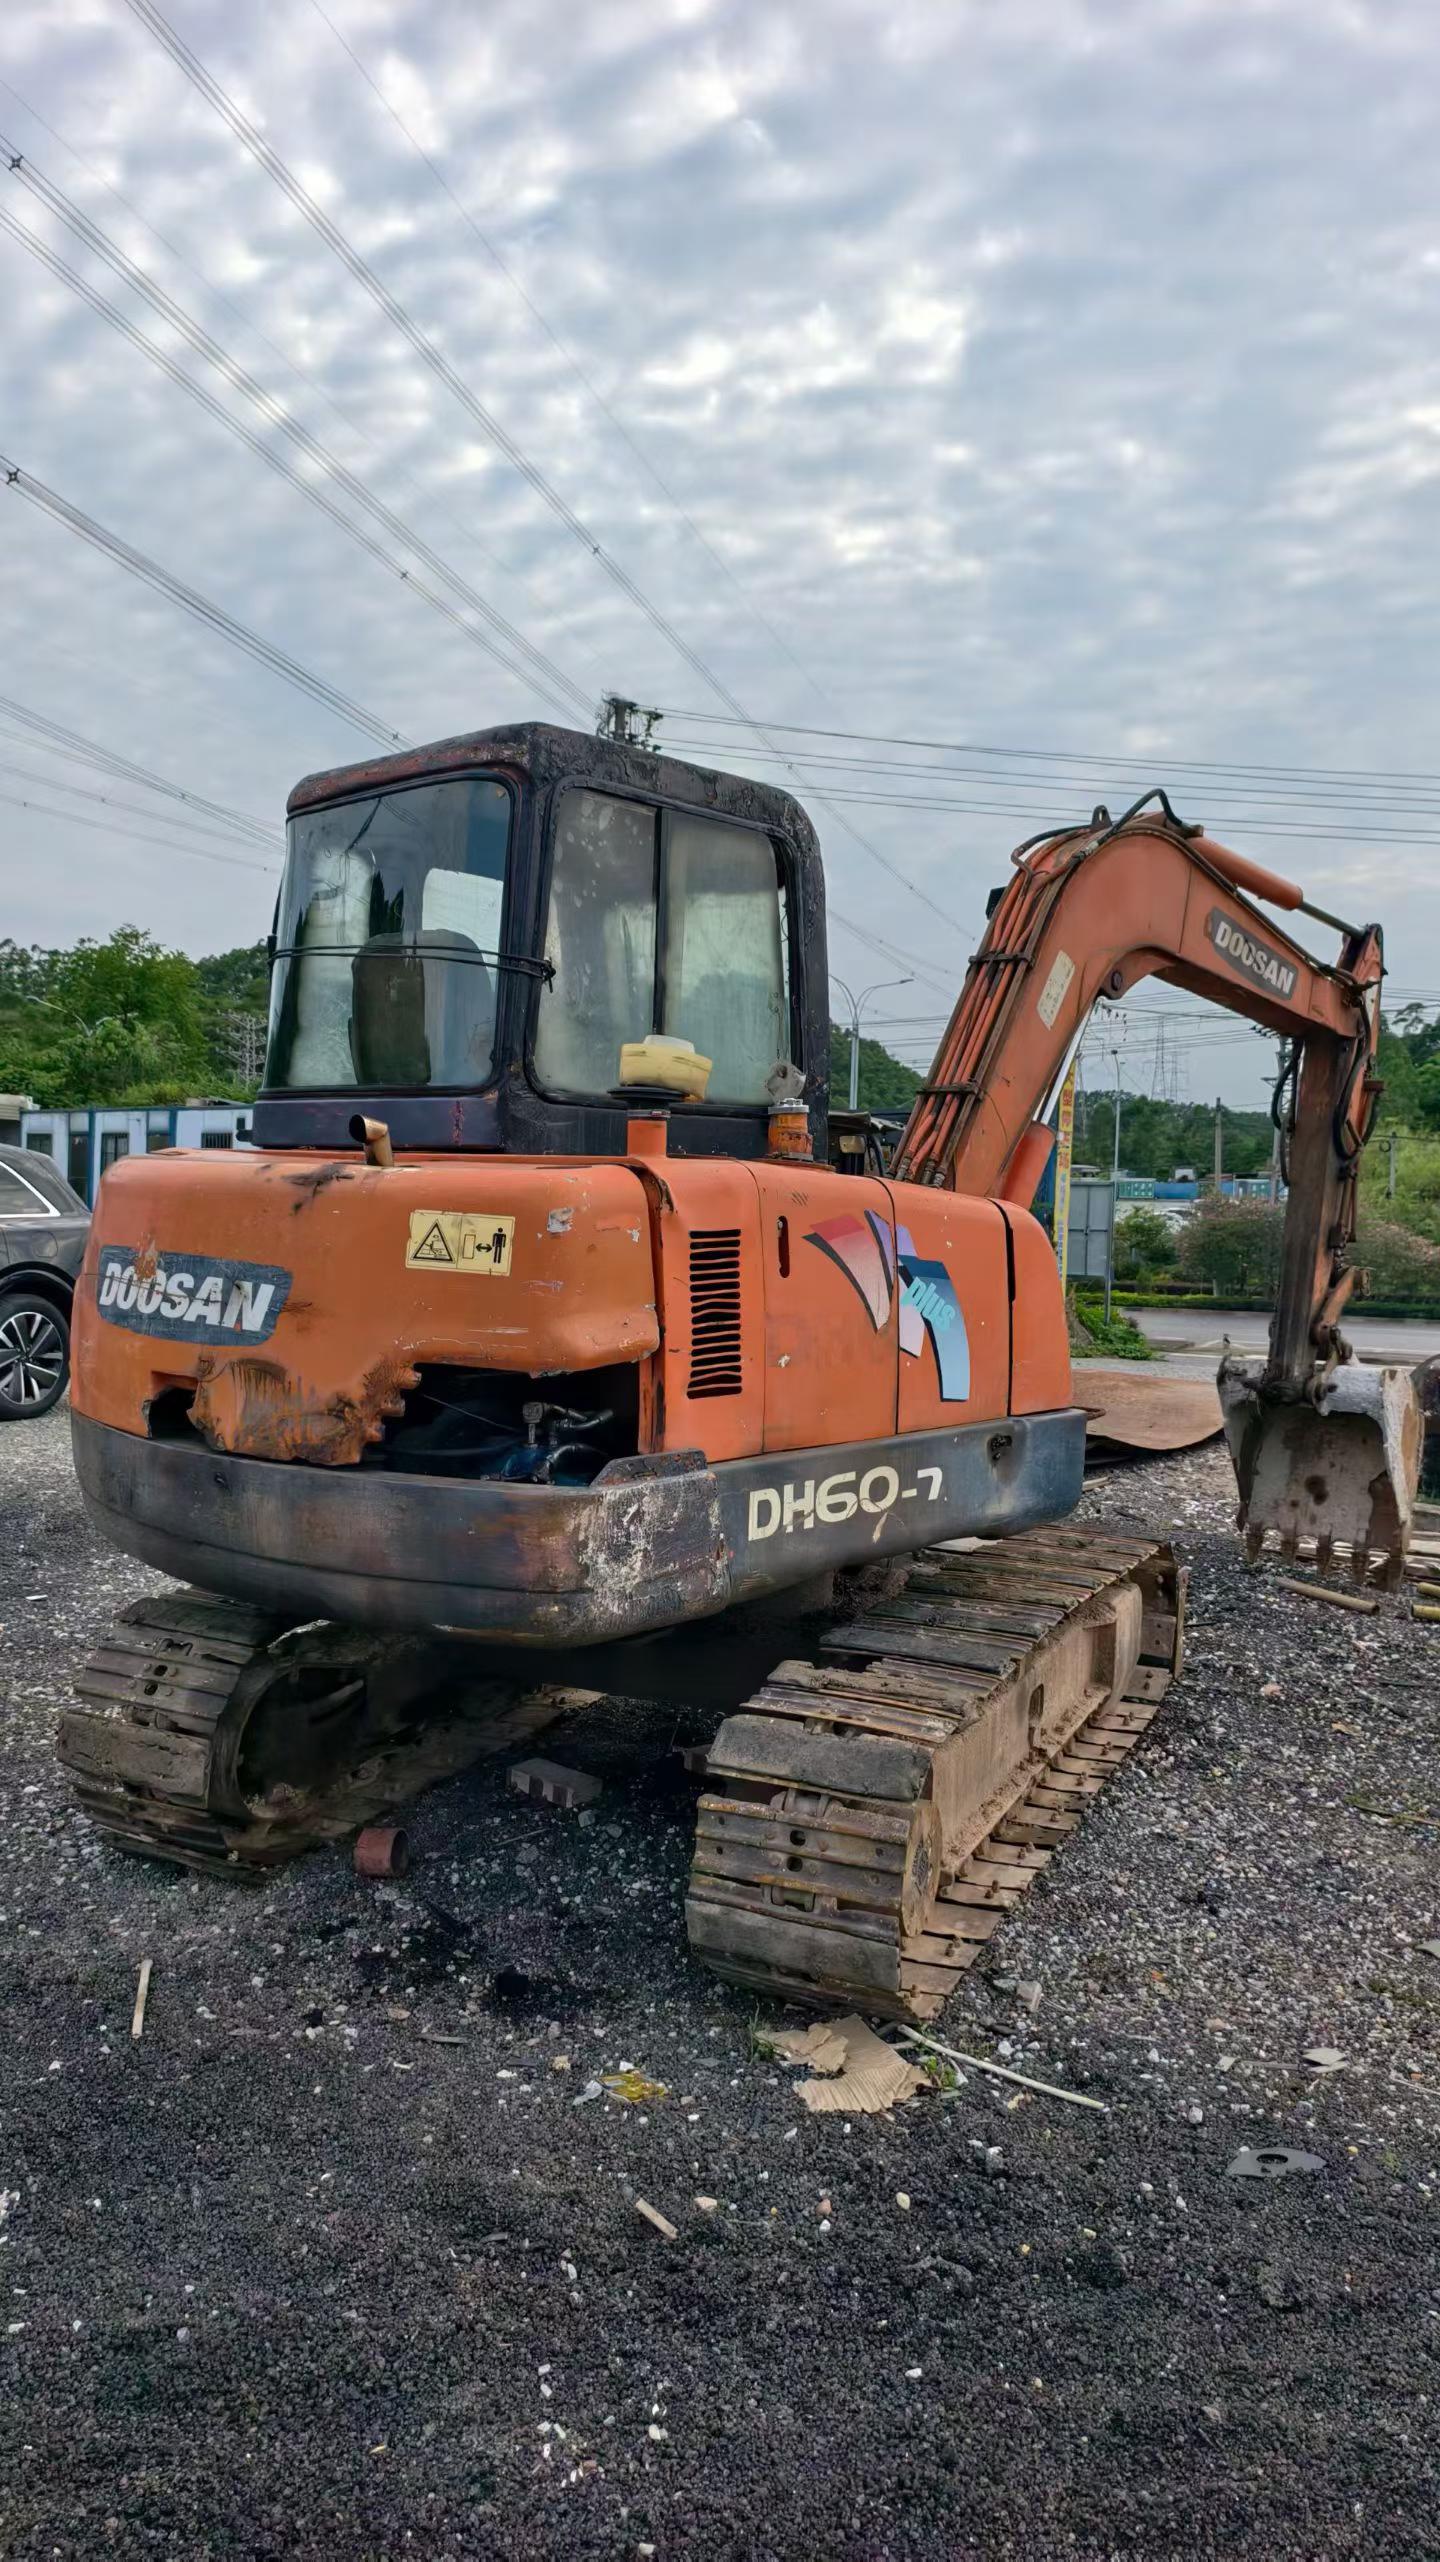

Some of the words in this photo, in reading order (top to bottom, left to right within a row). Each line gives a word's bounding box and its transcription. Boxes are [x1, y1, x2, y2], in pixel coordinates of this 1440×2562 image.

[1215, 921, 1294, 994] DOOSAN
[99, 1262, 275, 1332] DOOSAN
[901, 1276, 956, 1331] plus
[748, 1465, 943, 1541] DH60-7
